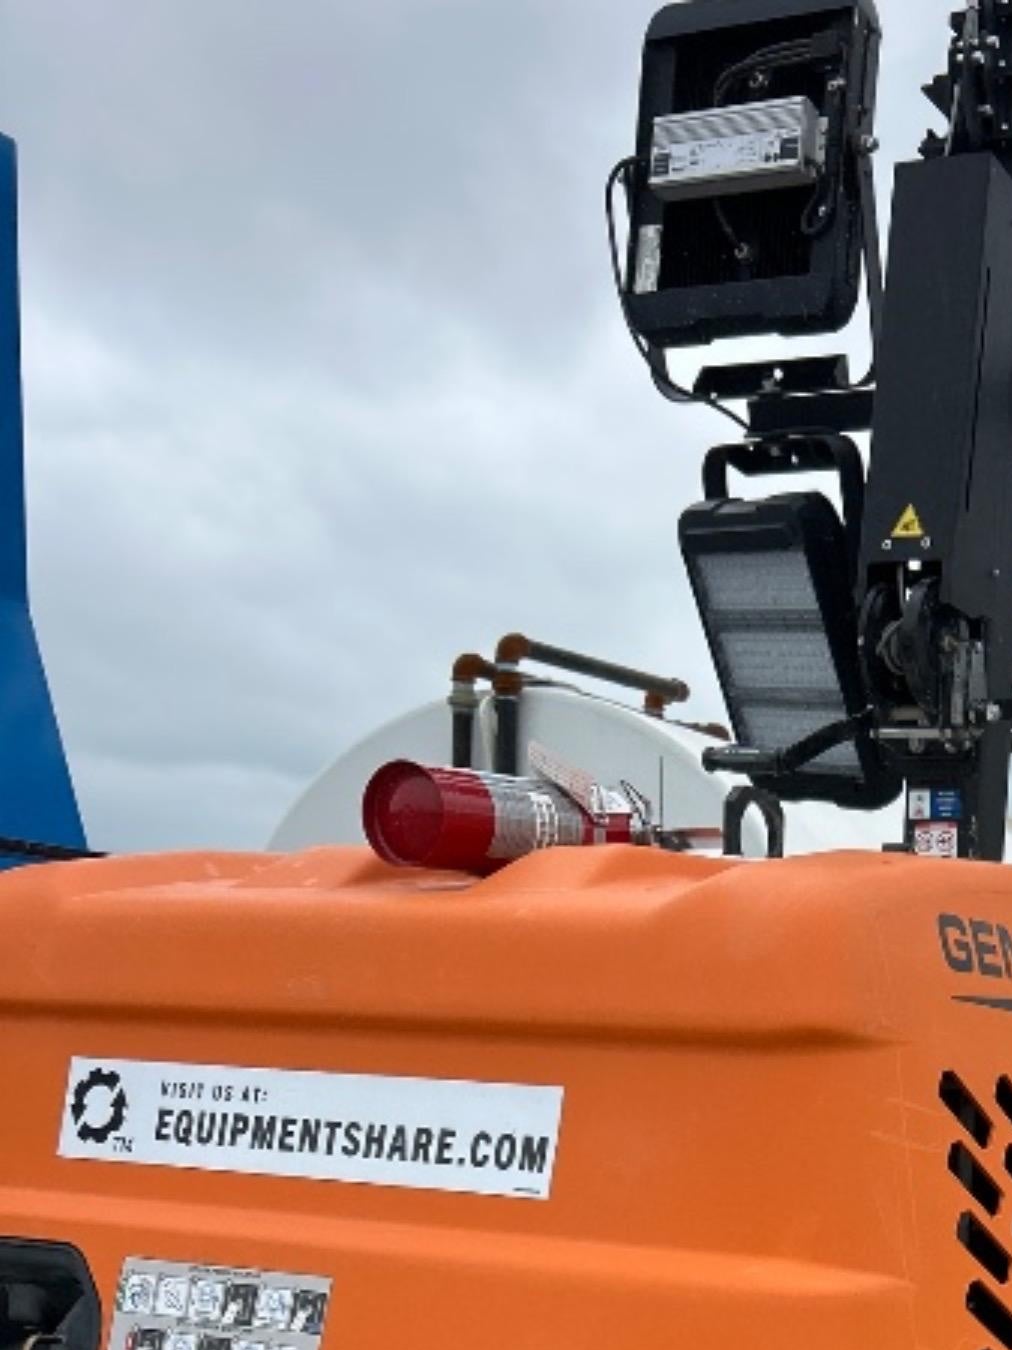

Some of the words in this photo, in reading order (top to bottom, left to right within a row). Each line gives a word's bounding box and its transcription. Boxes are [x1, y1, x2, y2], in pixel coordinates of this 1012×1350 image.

[160, 1080, 205, 1099] VISIT
[212, 1084, 234, 1102] US
[239, 1087, 268, 1104] AT:
[154, 1107, 550, 1174] EQUIPMENTSHARE.COM
